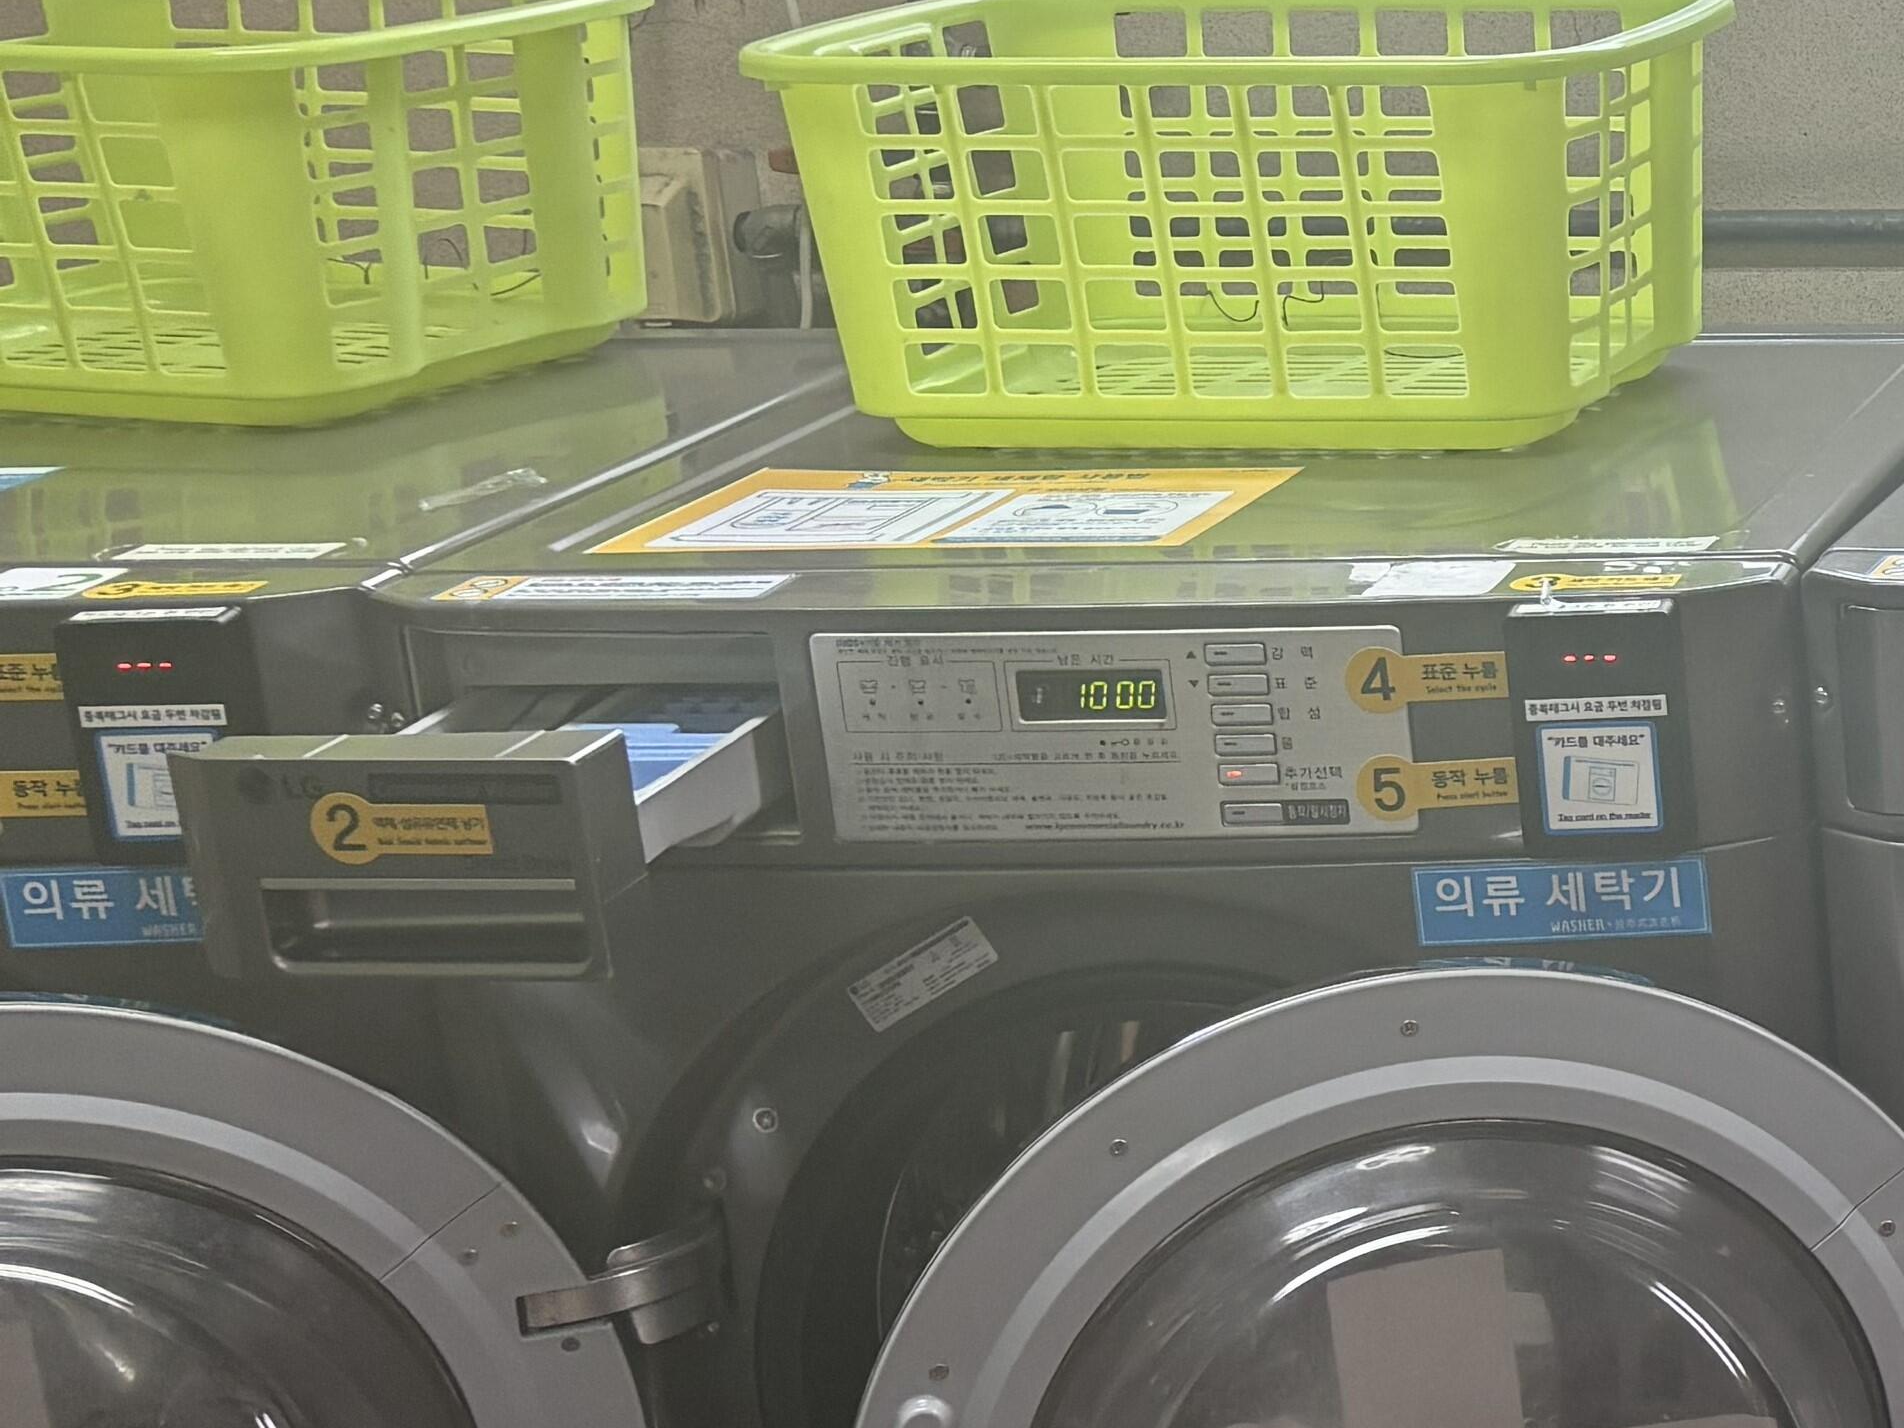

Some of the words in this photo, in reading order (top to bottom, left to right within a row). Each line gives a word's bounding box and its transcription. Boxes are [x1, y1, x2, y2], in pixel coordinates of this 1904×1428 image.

[1360, 656, 1396, 702] 4
[1421, 662, 1459, 681] 표준
[1461, 661, 1499, 681] 누름
[1373, 767, 1406, 812] 5
[1431, 768, 1466, 789] 동작
[1473, 767, 1510, 786] 누름
[325, 802, 368, 855] 2
[22, 879, 115, 921] 의류
[1435, 871, 1525, 917] 의류
[1545, 866, 1681, 913] 세탁기
